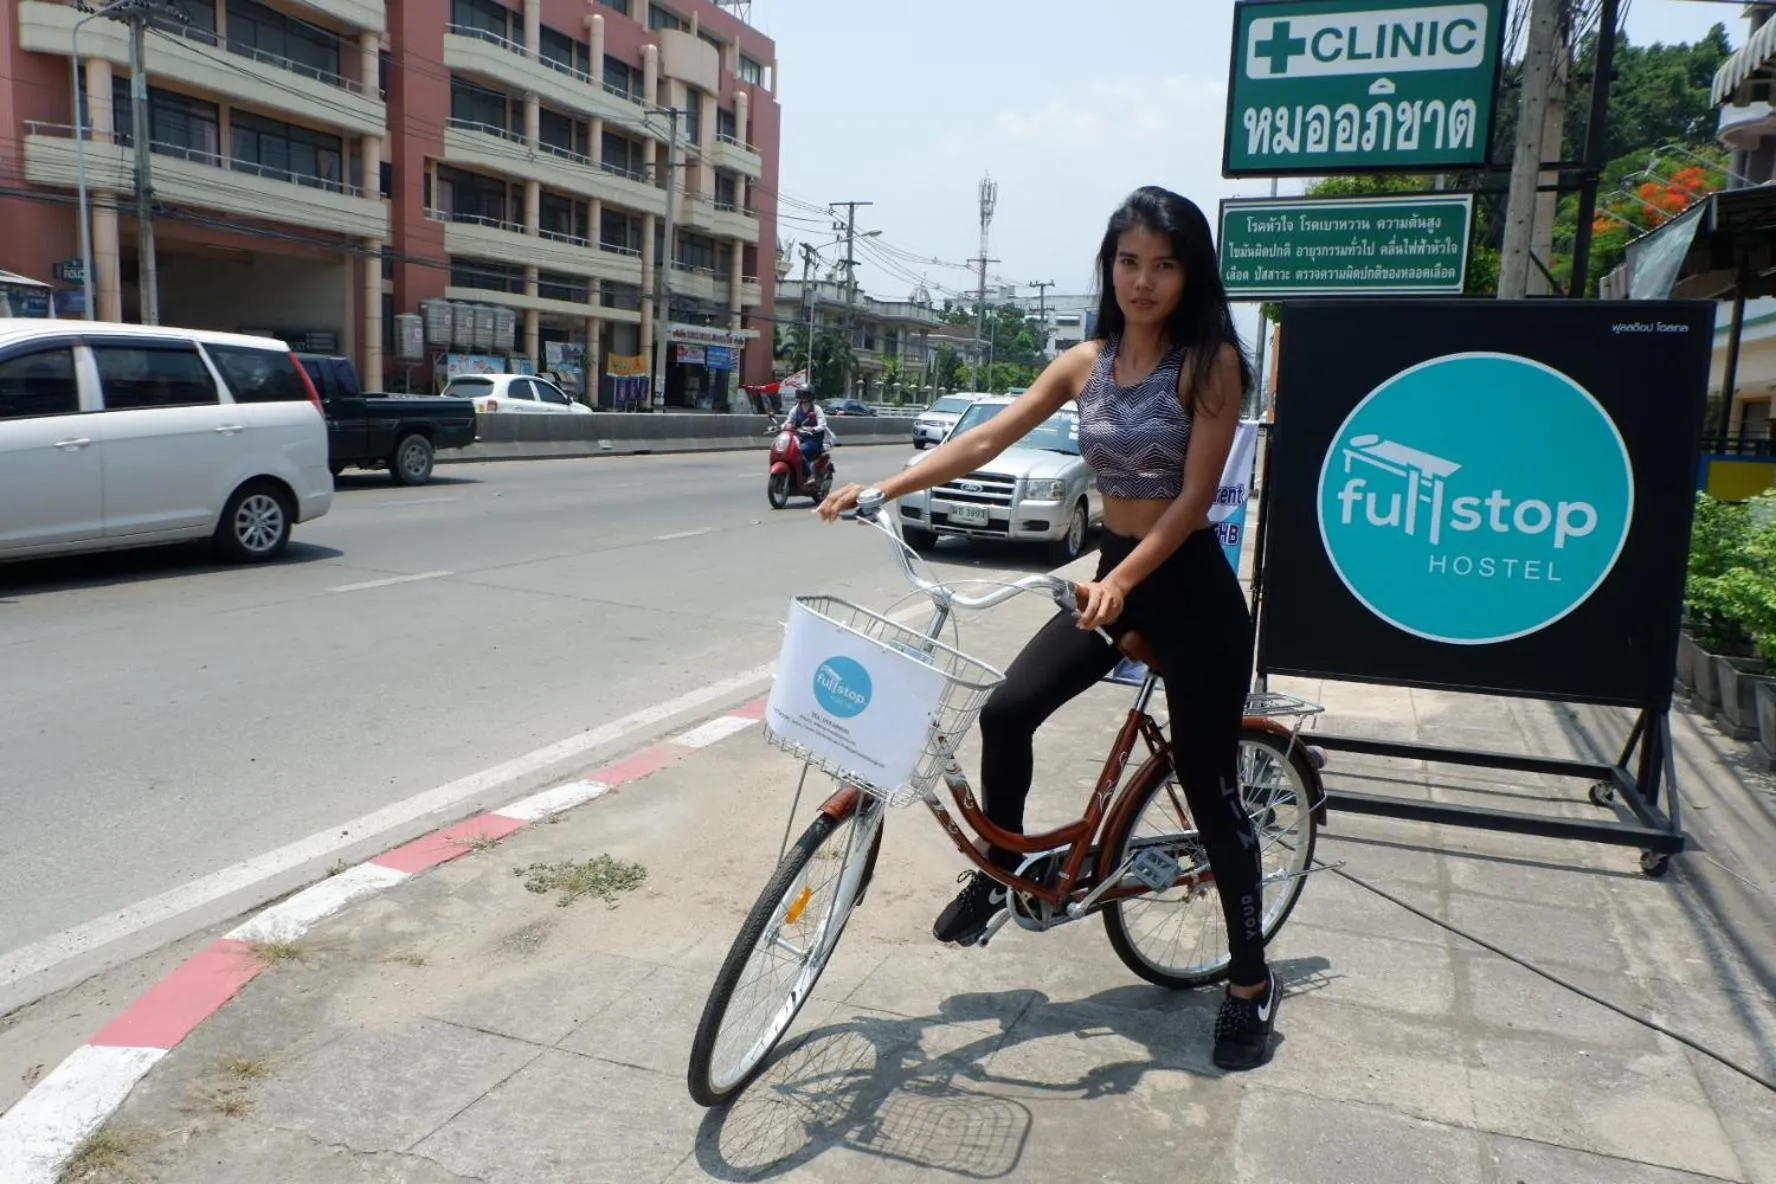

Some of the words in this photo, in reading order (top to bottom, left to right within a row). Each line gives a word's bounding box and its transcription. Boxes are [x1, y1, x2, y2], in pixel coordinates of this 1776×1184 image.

[1310, 17, 1478, 63] CLINIC
[1242, 76, 1478, 155] หมออภิชาต
[1246, 215, 1294, 233] โรคหัวใจ
[1300, 214, 1370, 232] โรคเบาหวาน
[1338, 470, 1598, 549] fullstop
[1428, 555, 1562, 581] HOSTEL
